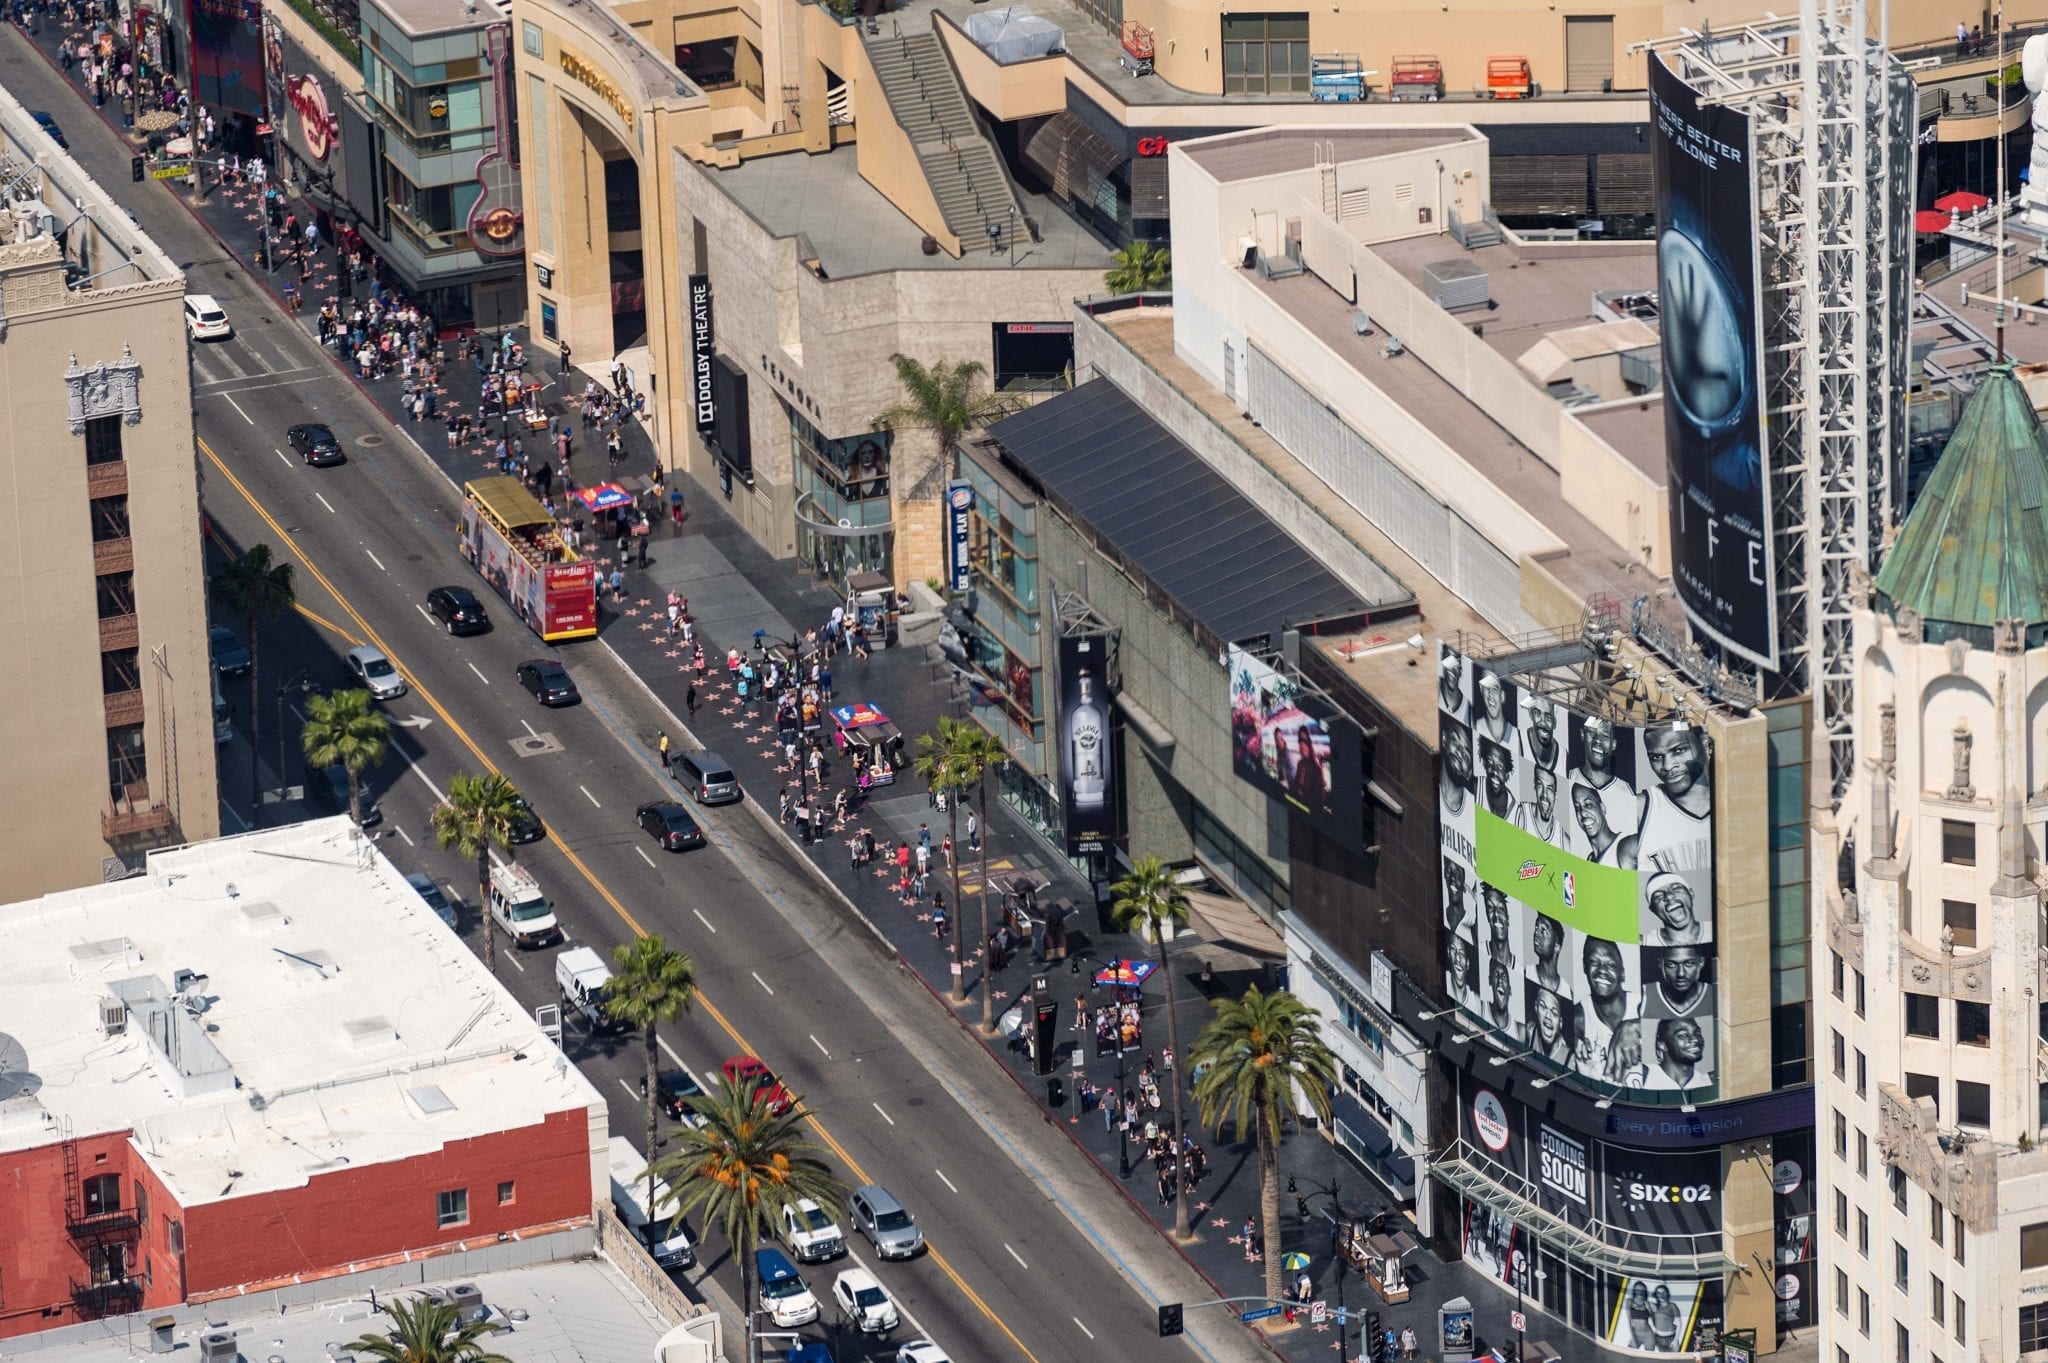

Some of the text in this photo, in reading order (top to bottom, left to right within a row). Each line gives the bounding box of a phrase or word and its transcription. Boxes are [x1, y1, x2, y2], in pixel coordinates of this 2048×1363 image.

[1658, 115, 1718, 170] OFF ALONE
[1659, 98, 1685, 132] WERE
[1687, 124, 1742, 163] BETTER
[693, 283, 712, 400] DOLBY THEATRE
[761, 354, 821, 421] SEPHORA
[956, 513, 968, 534] PLAY
[1679, 563, 1712, 602] MARCH
[1613, 1117, 1743, 1136] Every Dimension
[1541, 1131, 1585, 1170] COMING
[1541, 1151, 1586, 1198] SOON
[1630, 1183, 1712, 1202] SIX:02
[1244, 1311, 1270, 1320] Highland
